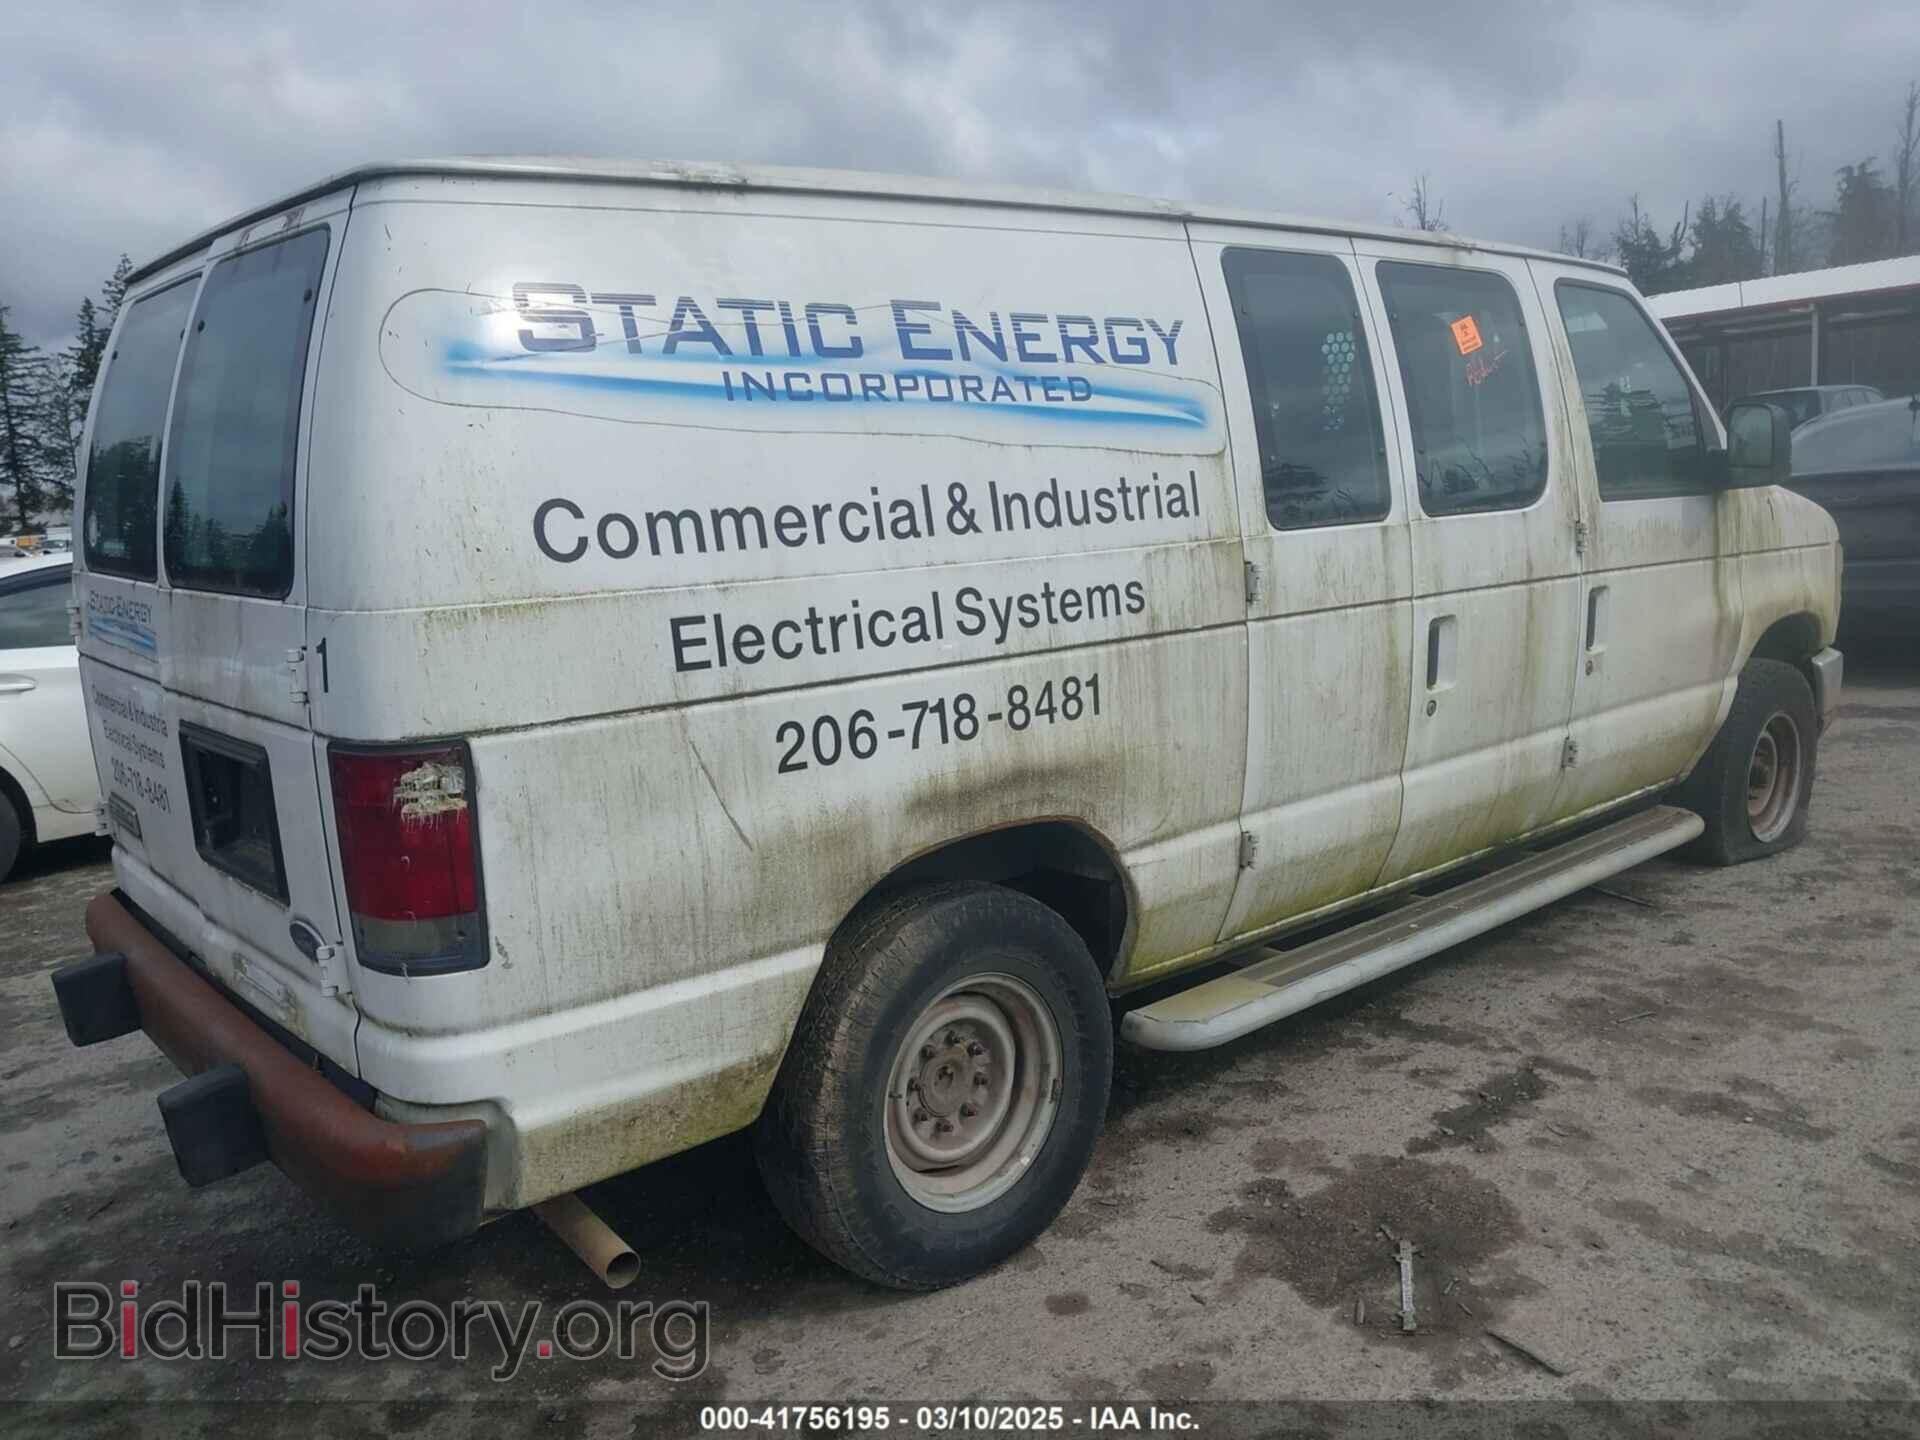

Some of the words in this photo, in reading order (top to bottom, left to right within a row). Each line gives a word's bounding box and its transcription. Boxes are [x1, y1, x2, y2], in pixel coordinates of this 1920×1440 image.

[512, 281, 865, 360] STATIC
[889, 299, 1185, 366] ENERGY
[721, 371, 1093, 403] INCORPORATED
[532, 483, 936, 564] Commercial
[946, 482, 983, 536] &
[988, 470, 1201, 532] Industrial
[315, 637, 329, 694] 1
[669, 590, 945, 673] Electrical
[956, 579, 1146, 645] Systems
[775, 672, 1102, 775] 206-718-8481
